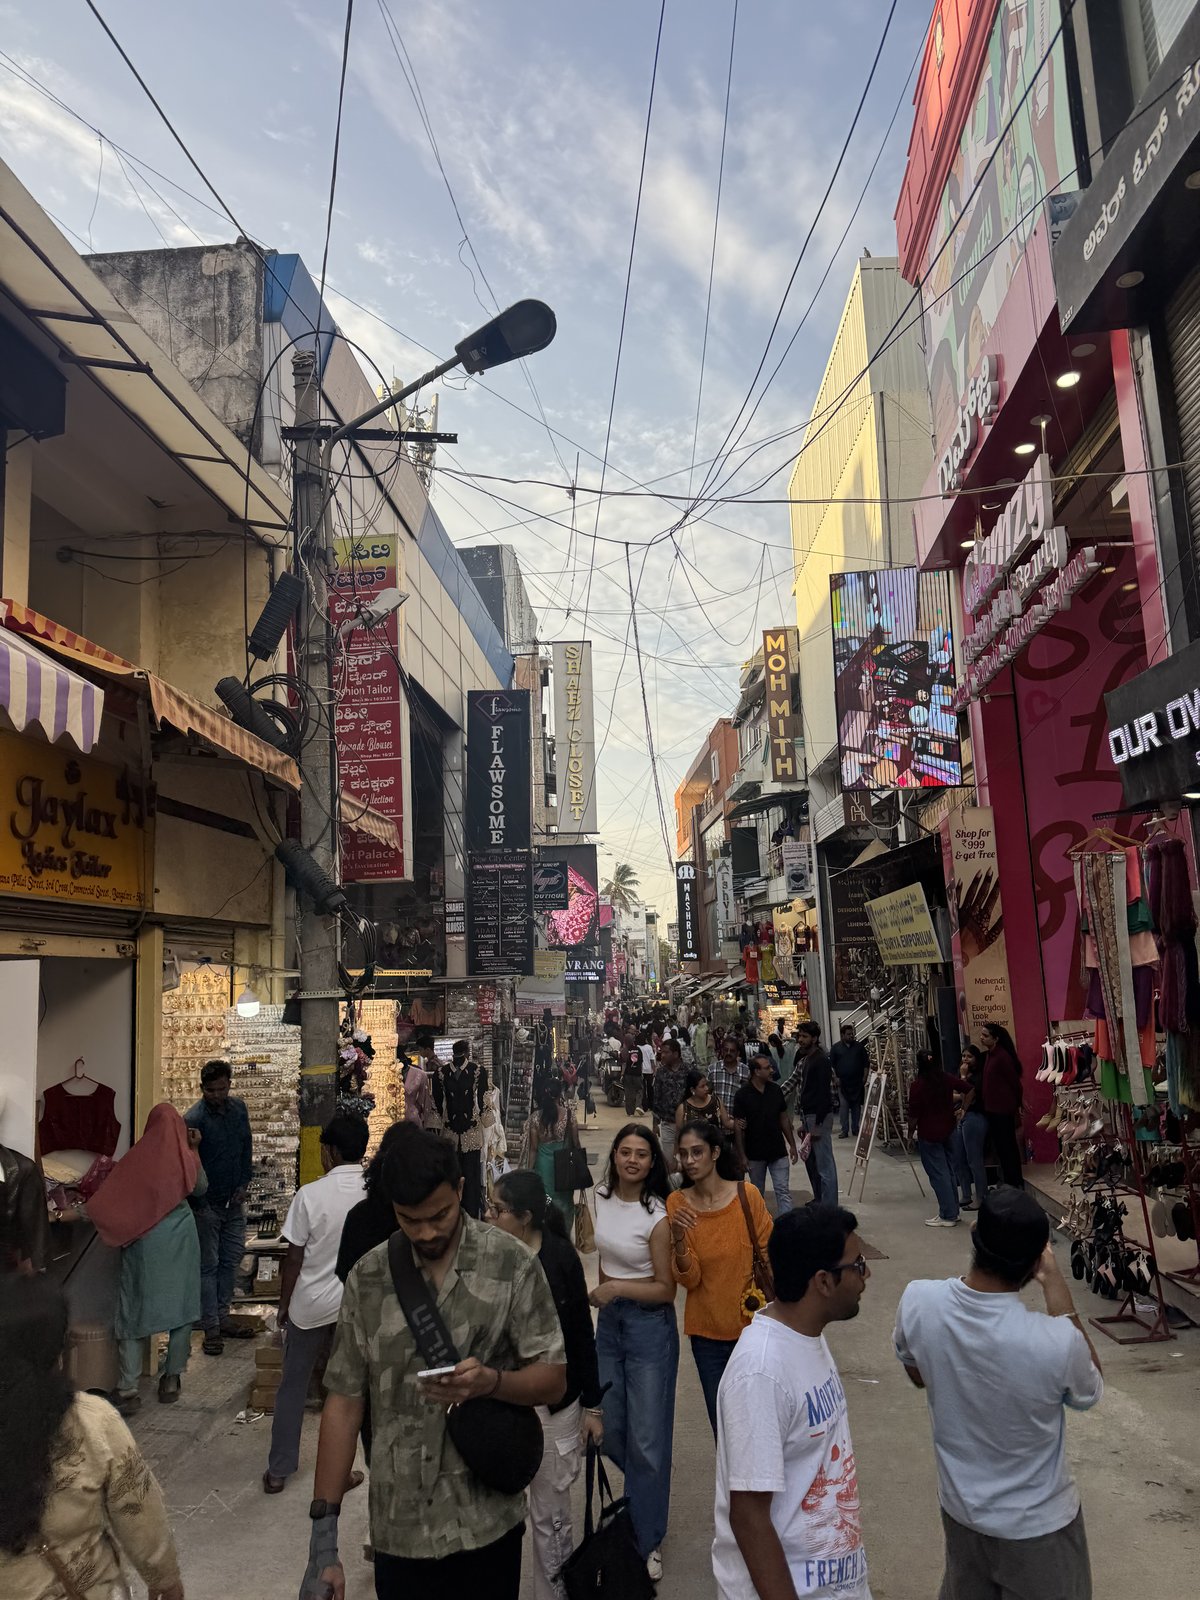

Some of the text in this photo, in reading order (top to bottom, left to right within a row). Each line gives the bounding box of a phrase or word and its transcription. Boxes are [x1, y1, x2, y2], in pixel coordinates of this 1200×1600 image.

[766, 634, 786, 692] MOH
[367, 684, 393, 695] Tailor
[770, 699, 793, 776] MITH
[1108, 712, 1163, 765] OUR
[367, 738, 393, 752] Blouses
[567, 728, 584, 820] CLOSET
[488, 725, 506, 844] FLAWSOME
[955, 828, 992, 841] Shop for
[358, 848, 396, 860] Palace
[503, 854, 527, 862] Center
[963, 851, 976, 862] get
[977, 850, 996, 860] Free
[683, 883, 693, 949] MASHROO
[974, 976, 1006, 985] Mehendi
[994, 984, 1006, 992] Art
[971, 1004, 1007, 1015] Everyday
[972, 1012, 989, 1020] look
[805, 1551, 858, 1587] FRENCH
